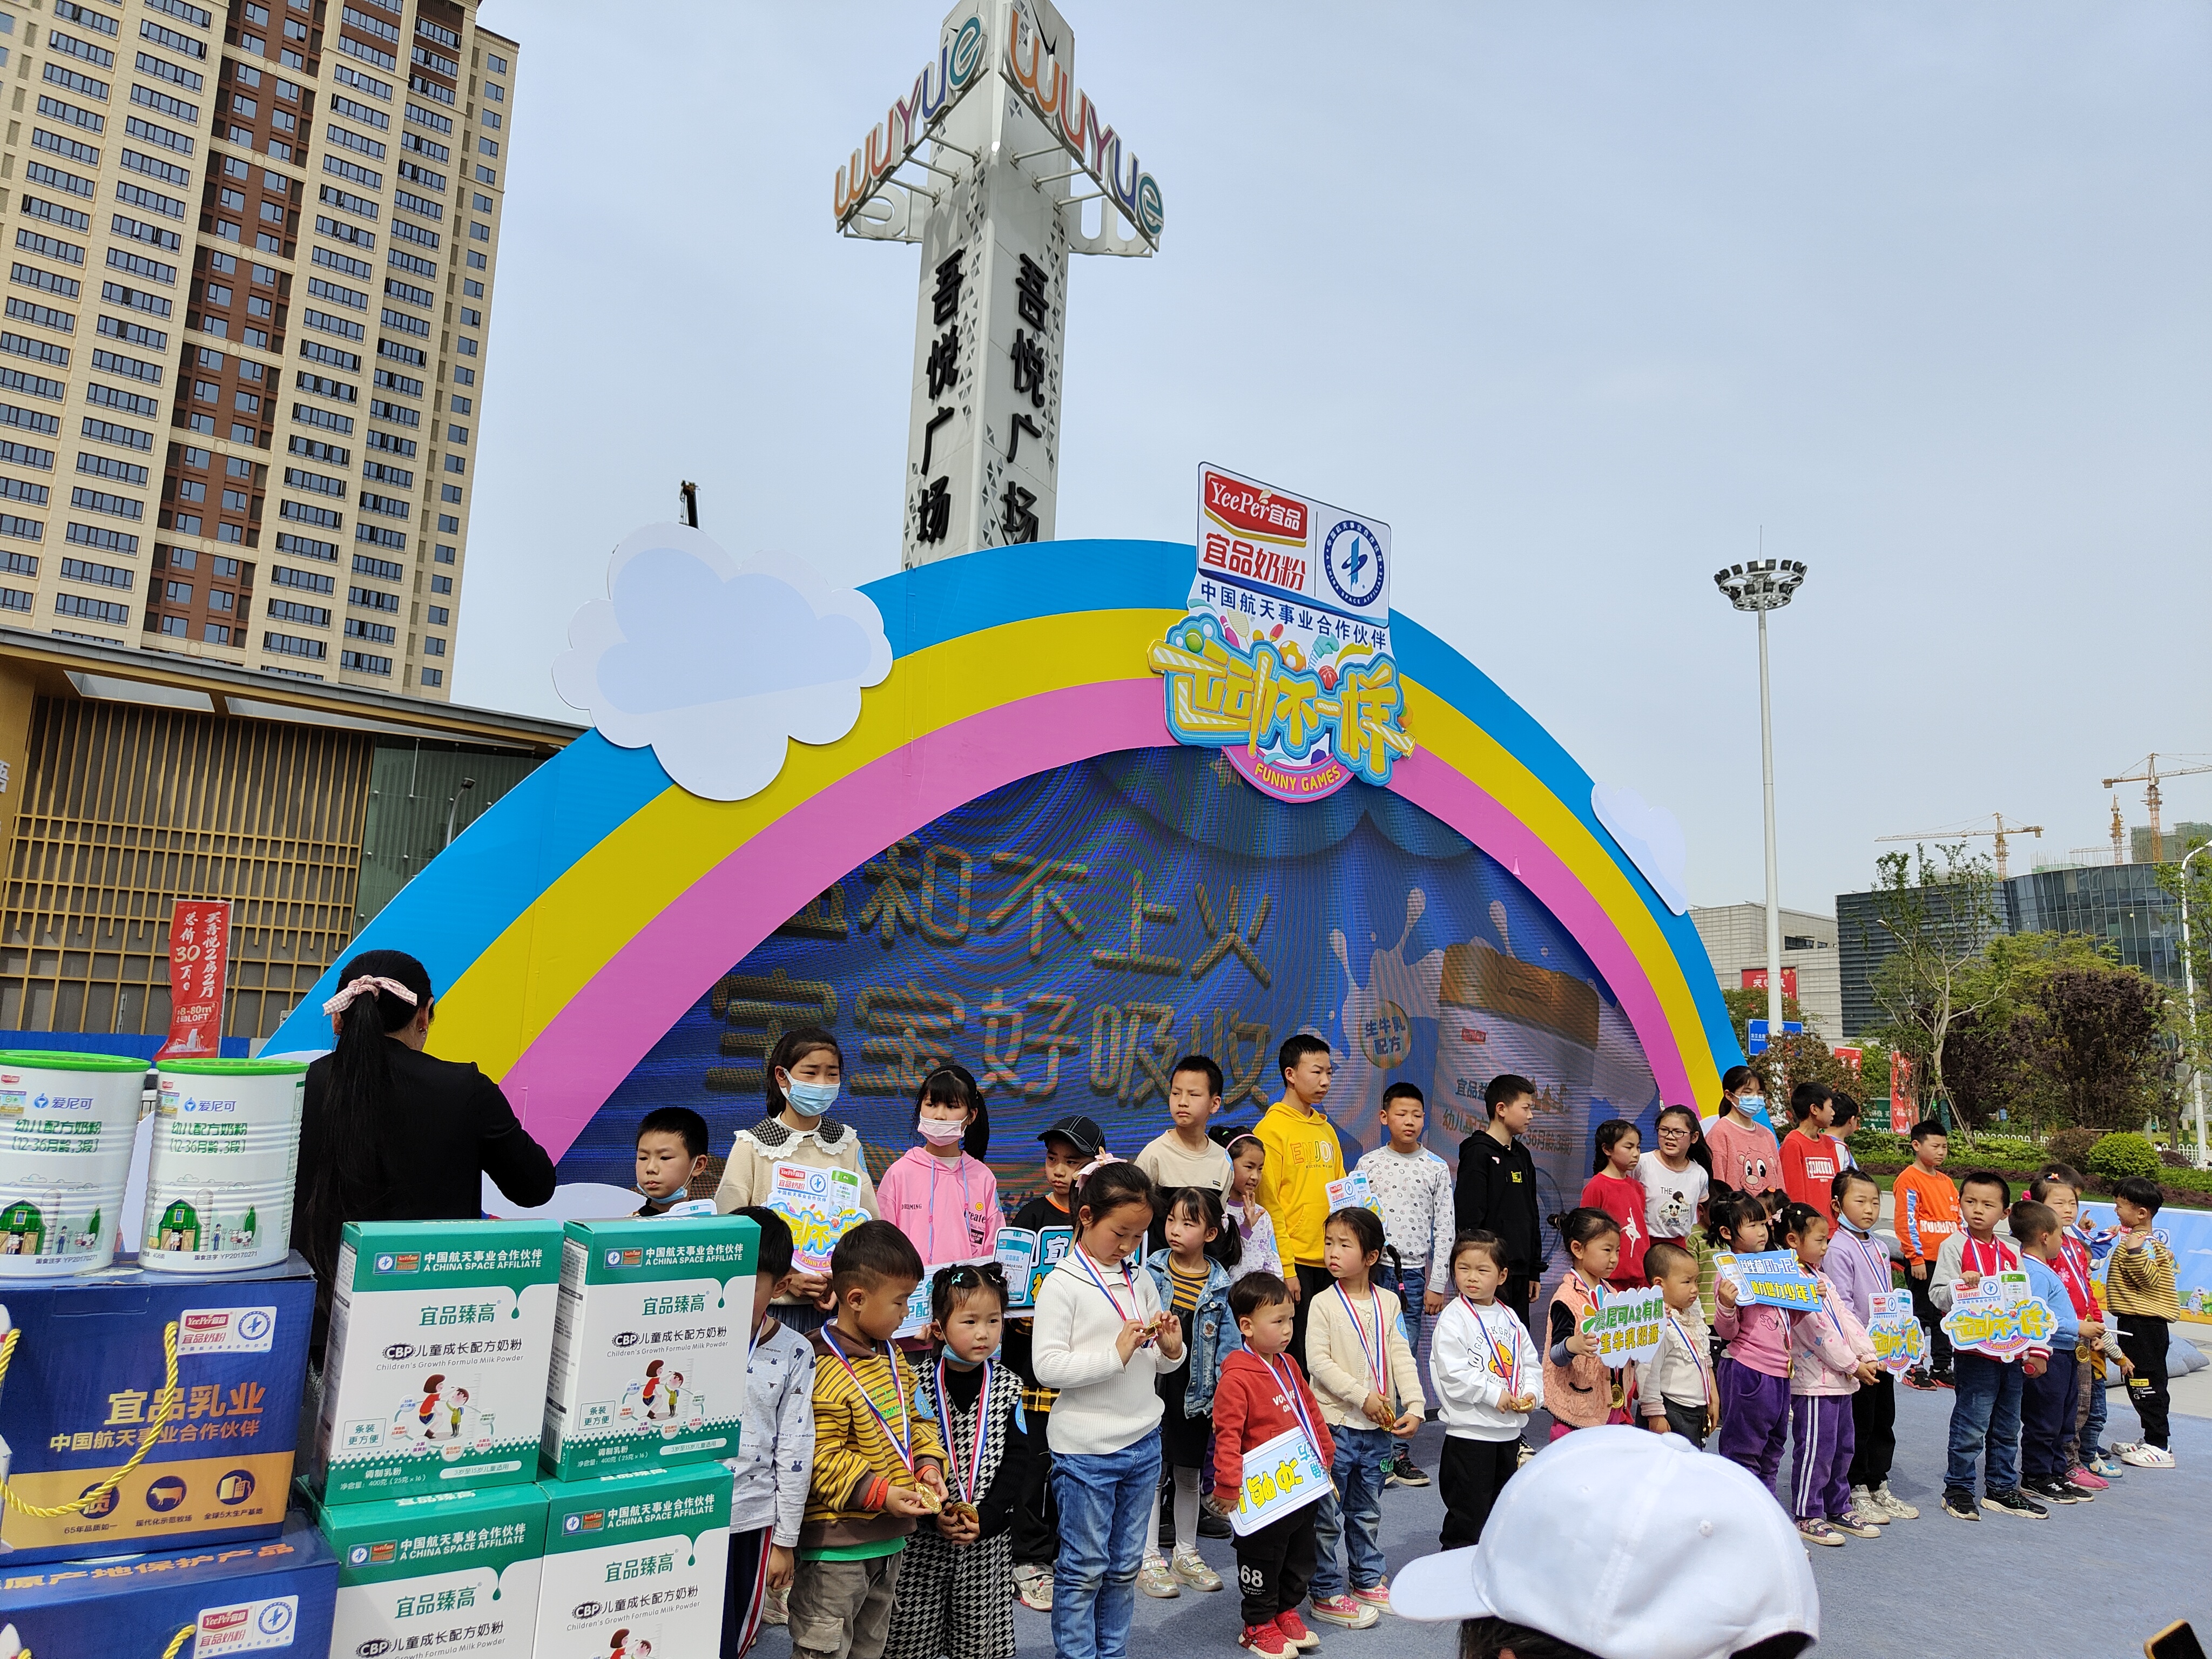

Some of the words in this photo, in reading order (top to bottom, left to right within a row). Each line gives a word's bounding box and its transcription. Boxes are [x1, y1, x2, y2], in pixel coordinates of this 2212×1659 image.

[916, 249, 965, 543] 吾悦广场
[1003, 252, 1049, 545] 吾悦广场
[1203, 532, 1306, 591] 宜品奶粉
[1340, 591, 1361, 605] SPACE
[1201, 581, 1387, 651] 中国航天事业合作伙伴
[1148, 644, 1416, 773] 运动不一样
[1255, 763, 1297, 791] FUNNY
[1300, 765, 1341, 792] GAMES
[1373, 1035, 1401, 1055] 配方
[51, 1097, 95, 1110] 爱尼可
[198, 1100, 237, 1112] 爱尼可
[14, 1119, 102, 1135] 幼儿配方奶粉
[171, 1121, 248, 1136] 幼儿配方奶粉
[777, 1190, 827, 1202] 中国航天事业合作伙伴
[1660, 1186, 1673, 1195] THE
[63, 1254, 98, 1264] YP20170271
[220, 1250, 258, 1260] YP20170271
[424, 1249, 543, 1264] 中国航天事业合作伙伴
[646, 1243, 744, 1258] 中国航天事业合作伙伴
[705, 1254, 743, 1263] AFFILIATE
[433, 1263, 463, 1271] CHINA
[465, 1262, 495, 1270] SPACE
[496, 1259, 542, 1269] AFFILIATE
[801, 1256, 820, 1267] FUNNY
[642, 1293, 706, 1316] 宜品臻高
[419, 1302, 497, 1326] 宜品臻高
[1594, 1297, 1664, 1332] 爱尼可A2有机
[181, 1332, 226, 1344] 宜品奶粉
[613, 1333, 638, 1346] CBP
[639, 1326, 727, 1345] 儿童成长配方奶粉
[1599, 1323, 1660, 1354] 生牛乳奶源
[2008, 1337, 2025, 1349] GAMES
[384, 1345, 414, 1359] CBP
[415, 1338, 522, 1358] 儿童成长配方奶粉
[606, 1349, 640, 1358] Children's
[642, 1346, 665, 1355] Growth
[376, 1362, 416, 1371] Children's
[418, 1359, 446, 1368] Growth
[447, 1357, 478, 1366] Formula
[479, 1355, 495, 1364] Milk
[496, 1354, 524, 1363] Powder
[103, 1380, 266, 1425] 宜品乳业
[589, 1406, 607, 1415] 条装
[354, 1423, 376, 1434] 条装
[584, 1415, 610, 1426] 更方便
[50, 1419, 260, 1452] 中国航天事业合作伙伴
[348, 1434, 380, 1446] 更方便
[598, 1445, 629, 1456] 调制乳粉
[365, 1467, 402, 1479] 调制乳粉
[454, 1463, 509, 1475] 3岁至15岁儿童适用
[204, 1507, 264, 1521] 全球5大生产基地
[607, 1493, 715, 1520] 中国航天事业合作伙伴
[135, 1514, 193, 1527] 现代化示范牧场
[607, 1520, 615, 1528] A
[616, 1516, 643, 1526] CHINA
[644, 1512, 672, 1522] SPACE
[673, 1505, 714, 1518] AFFILIATE
[64, 1522, 118, 1534] 65年品质如一
[400, 1522, 527, 1552] 中国航天事业合作伙伴
[399, 1552, 408, 1561] A
[409, 1549, 441, 1559] CHINA
[443, 1543, 475, 1554] SPACE
[477, 1535, 525, 1549] AFFILIATE
[604, 1552, 675, 1583] 宜品臻高
[1240, 1564, 1263, 1587] 68
[394, 1586, 477, 1619] 宜品臻高
[575, 1602, 601, 1618] CBP
[602, 1584, 699, 1614] 儿童成长配方奶粉
[567, 1619, 603, 1631] Children's
[604, 1614, 630, 1625] Growth
[631, 1610, 659, 1620] Formula
[660, 1606, 675, 1614] Milk
[676, 1600, 700, 1611] Powder
[199, 1629, 246, 1647] 宜品奶粉
[358, 1640, 390, 1657] CBP
[390, 1620, 504, 1653] 儿童成长配方奶粉
[425, 1646, 457, 1658] Formula
[459, 1643, 475, 1652] Milk
[477, 1637, 506, 1649] Powder
